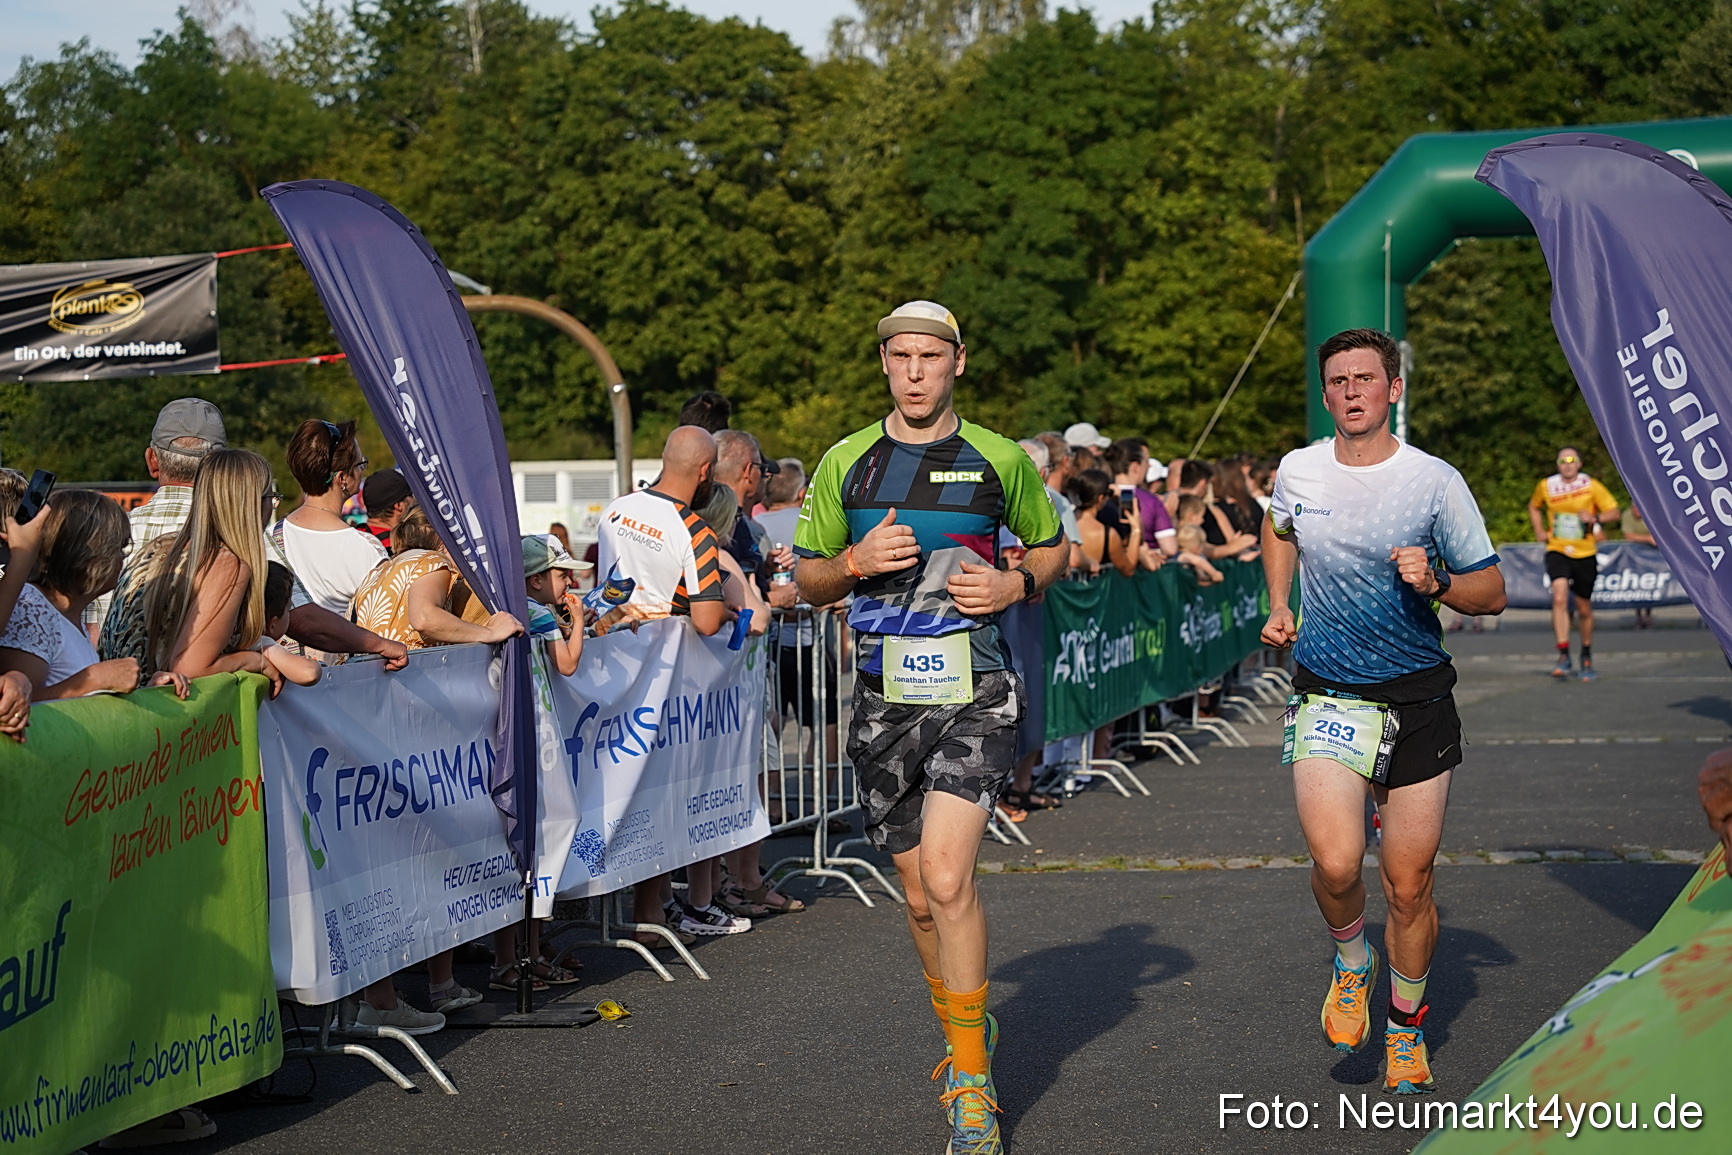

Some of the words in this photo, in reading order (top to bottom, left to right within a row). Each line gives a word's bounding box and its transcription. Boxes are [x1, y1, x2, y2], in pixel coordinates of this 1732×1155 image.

[14, 346, 38, 361] Ein
[41, 345, 71, 360] Ort,
[74, 344, 100, 359] der
[104, 341, 187, 357] verbindet.
[929, 471, 985, 483] BOCK
[617, 527, 663, 552] DYNAMICS
[621, 516, 664, 542] KLEBL
[893, 675, 927, 684] Jonathan
[929, 675, 961, 684] Taucher
[902, 654, 945, 672] 435
[593, 686, 741, 770] FRISCHMANN
[1314, 719, 1356, 742] 263
[1303, 734, 1326, 742] Niklas
[1327, 737, 1365, 757] Blöchinger
[64, 727, 173, 827] Gesunde
[175, 712, 241, 776] Firmen
[1374, 755, 1385, 777] HILTL
[335, 738, 498, 832] FRISCHMAN
[687, 793, 710, 817] HEUTE
[710, 784, 745, 810] GEDACHT,
[109, 802, 172, 884] laufen
[179, 773, 264, 846] länger
[687, 818, 720, 846] MORGEN
[719, 810, 753, 836] GEMACHT.
[443, 861, 483, 892] HEUTE
[482, 851, 519, 881] GEDAC
[447, 892, 489, 926] MORGEN
[345, 911, 383, 944] CORPORATE
[350, 932, 388, 967] CORPORATE
